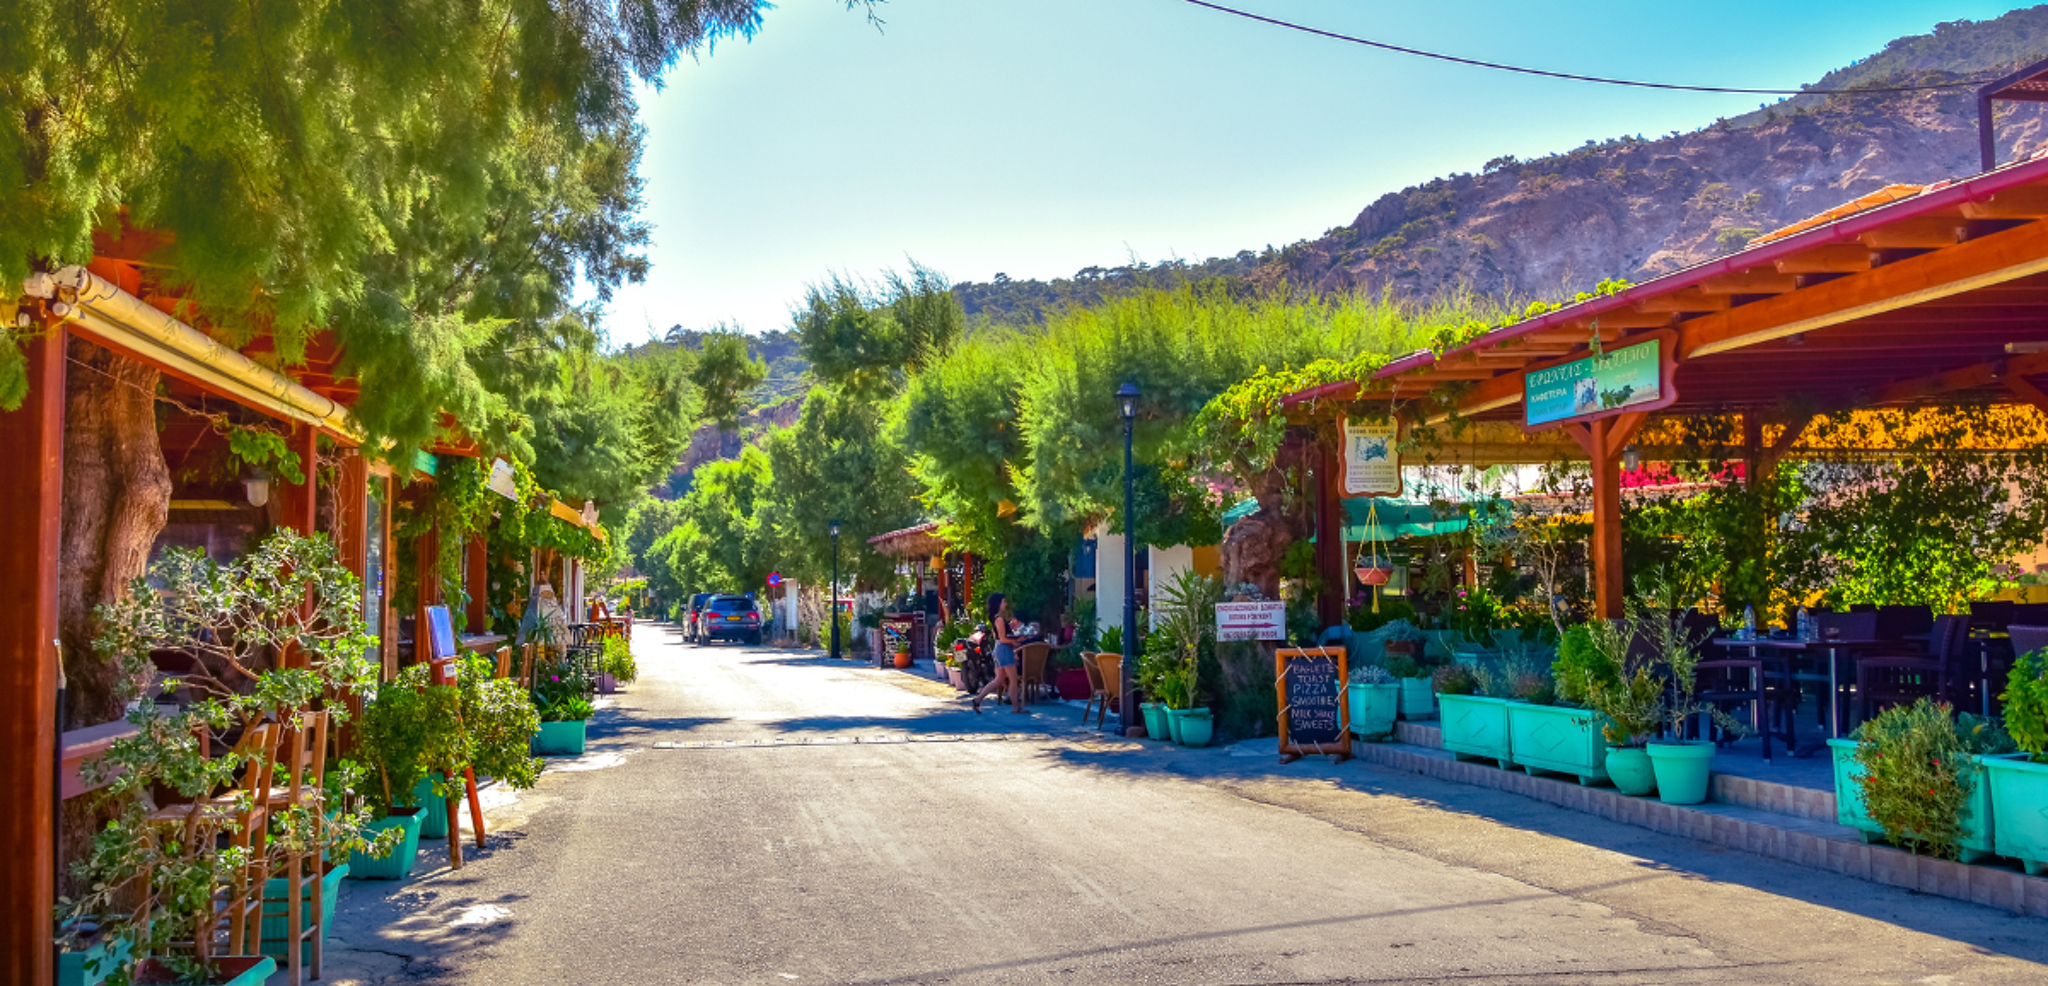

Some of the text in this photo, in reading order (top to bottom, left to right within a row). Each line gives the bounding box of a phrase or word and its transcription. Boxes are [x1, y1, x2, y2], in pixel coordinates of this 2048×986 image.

[1293, 664, 1334, 674] BAGUETTE
[1297, 675, 1330, 684] TOAST
[1293, 683, 1327, 695] PIZZA
[1291, 708, 1312, 719] MILK
[1294, 719, 1335, 731] SWEETS
